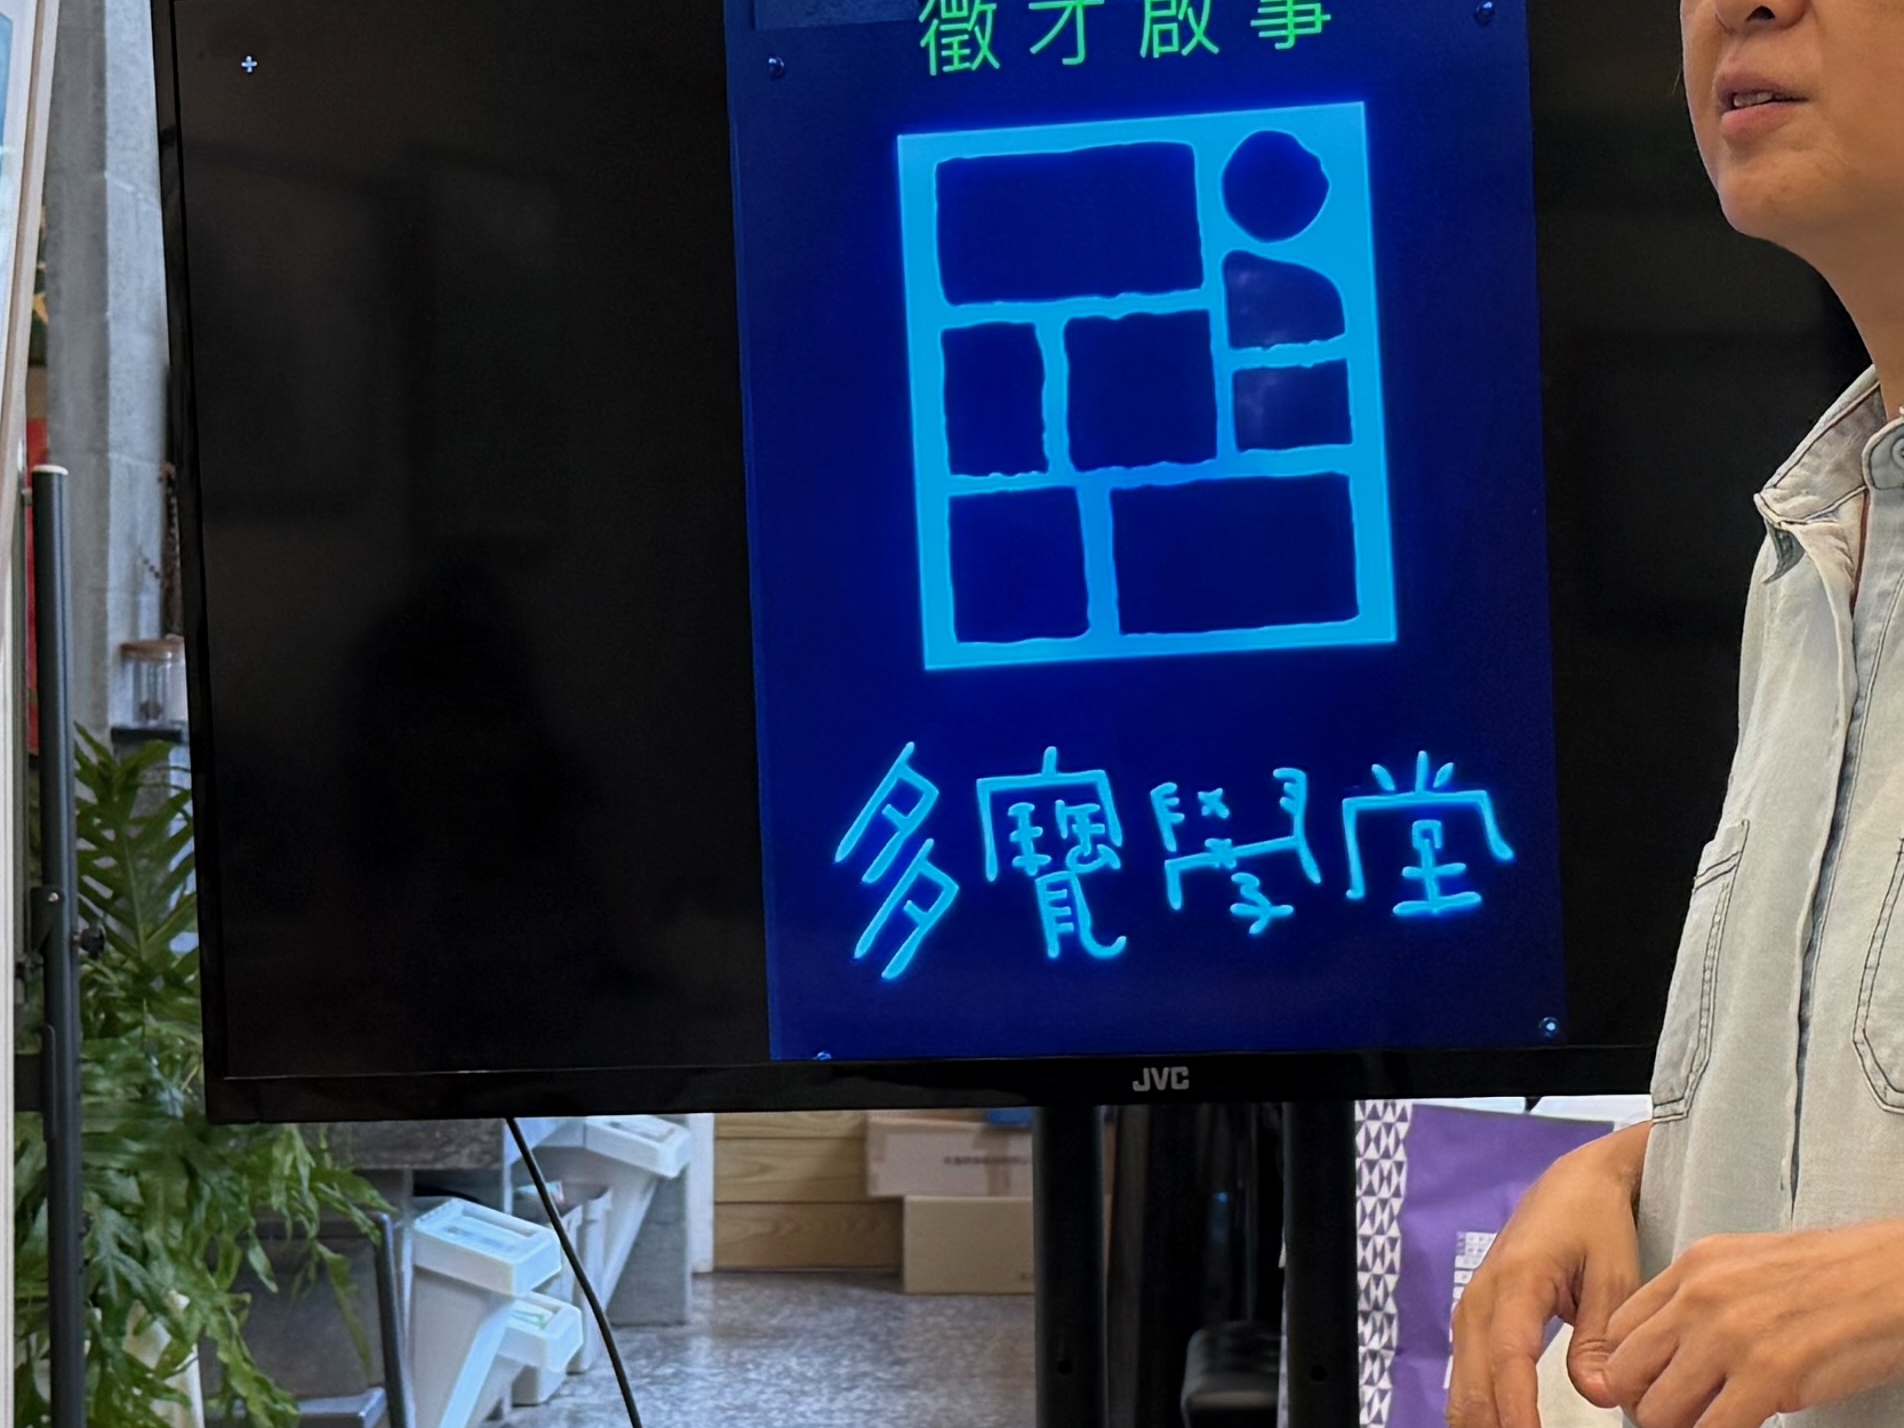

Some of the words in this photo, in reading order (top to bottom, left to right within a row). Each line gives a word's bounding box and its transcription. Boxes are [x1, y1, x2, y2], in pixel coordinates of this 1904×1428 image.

[834, 742, 1515, 981] 多寶學堂
[1132, 1066, 1190, 1092] JVC
